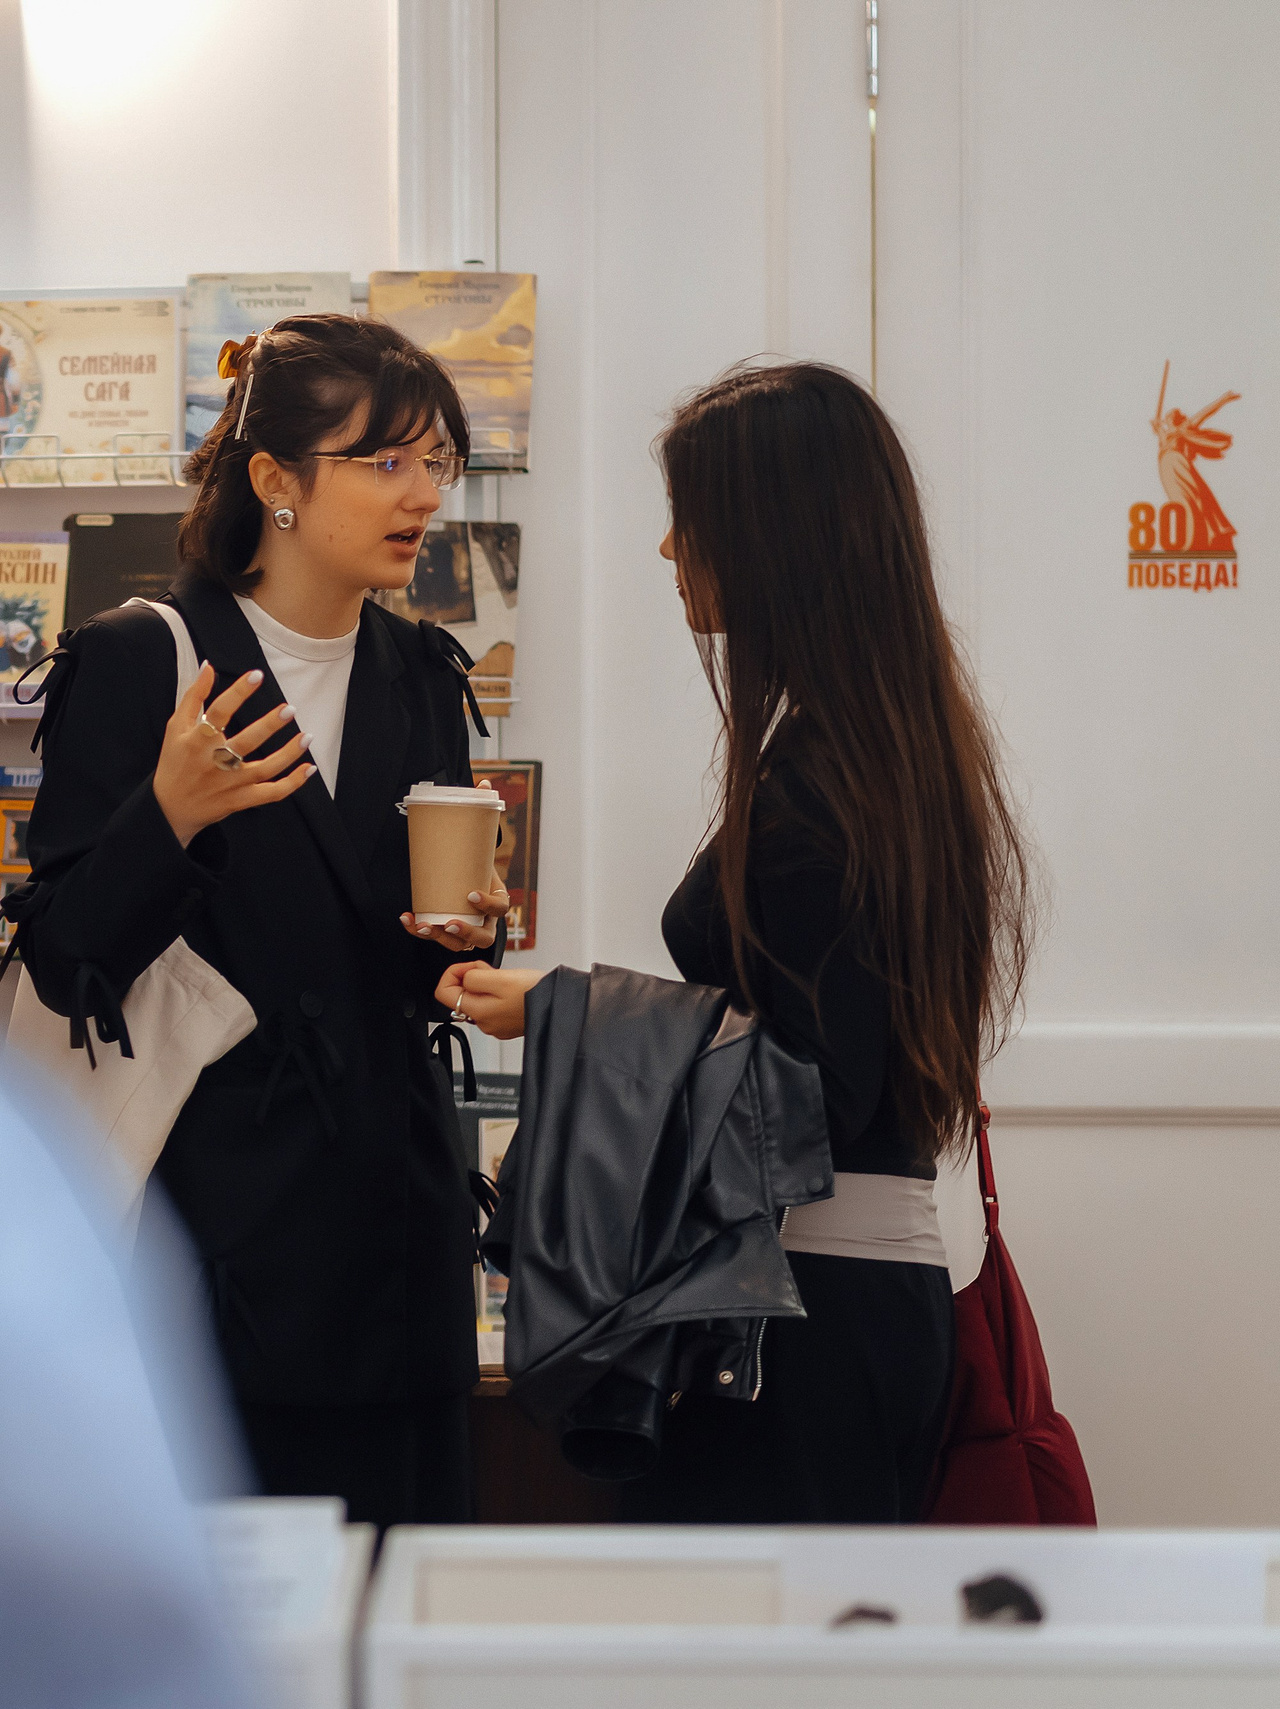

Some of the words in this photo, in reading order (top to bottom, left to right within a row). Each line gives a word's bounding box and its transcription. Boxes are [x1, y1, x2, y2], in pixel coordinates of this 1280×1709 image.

[58, 352, 157, 376] СЕМЕЙНАЯ
[83, 380, 131, 402] САГА
[1128, 502, 1187, 552] 80
[1128, 562, 1238, 592] ПОБЕДА!
